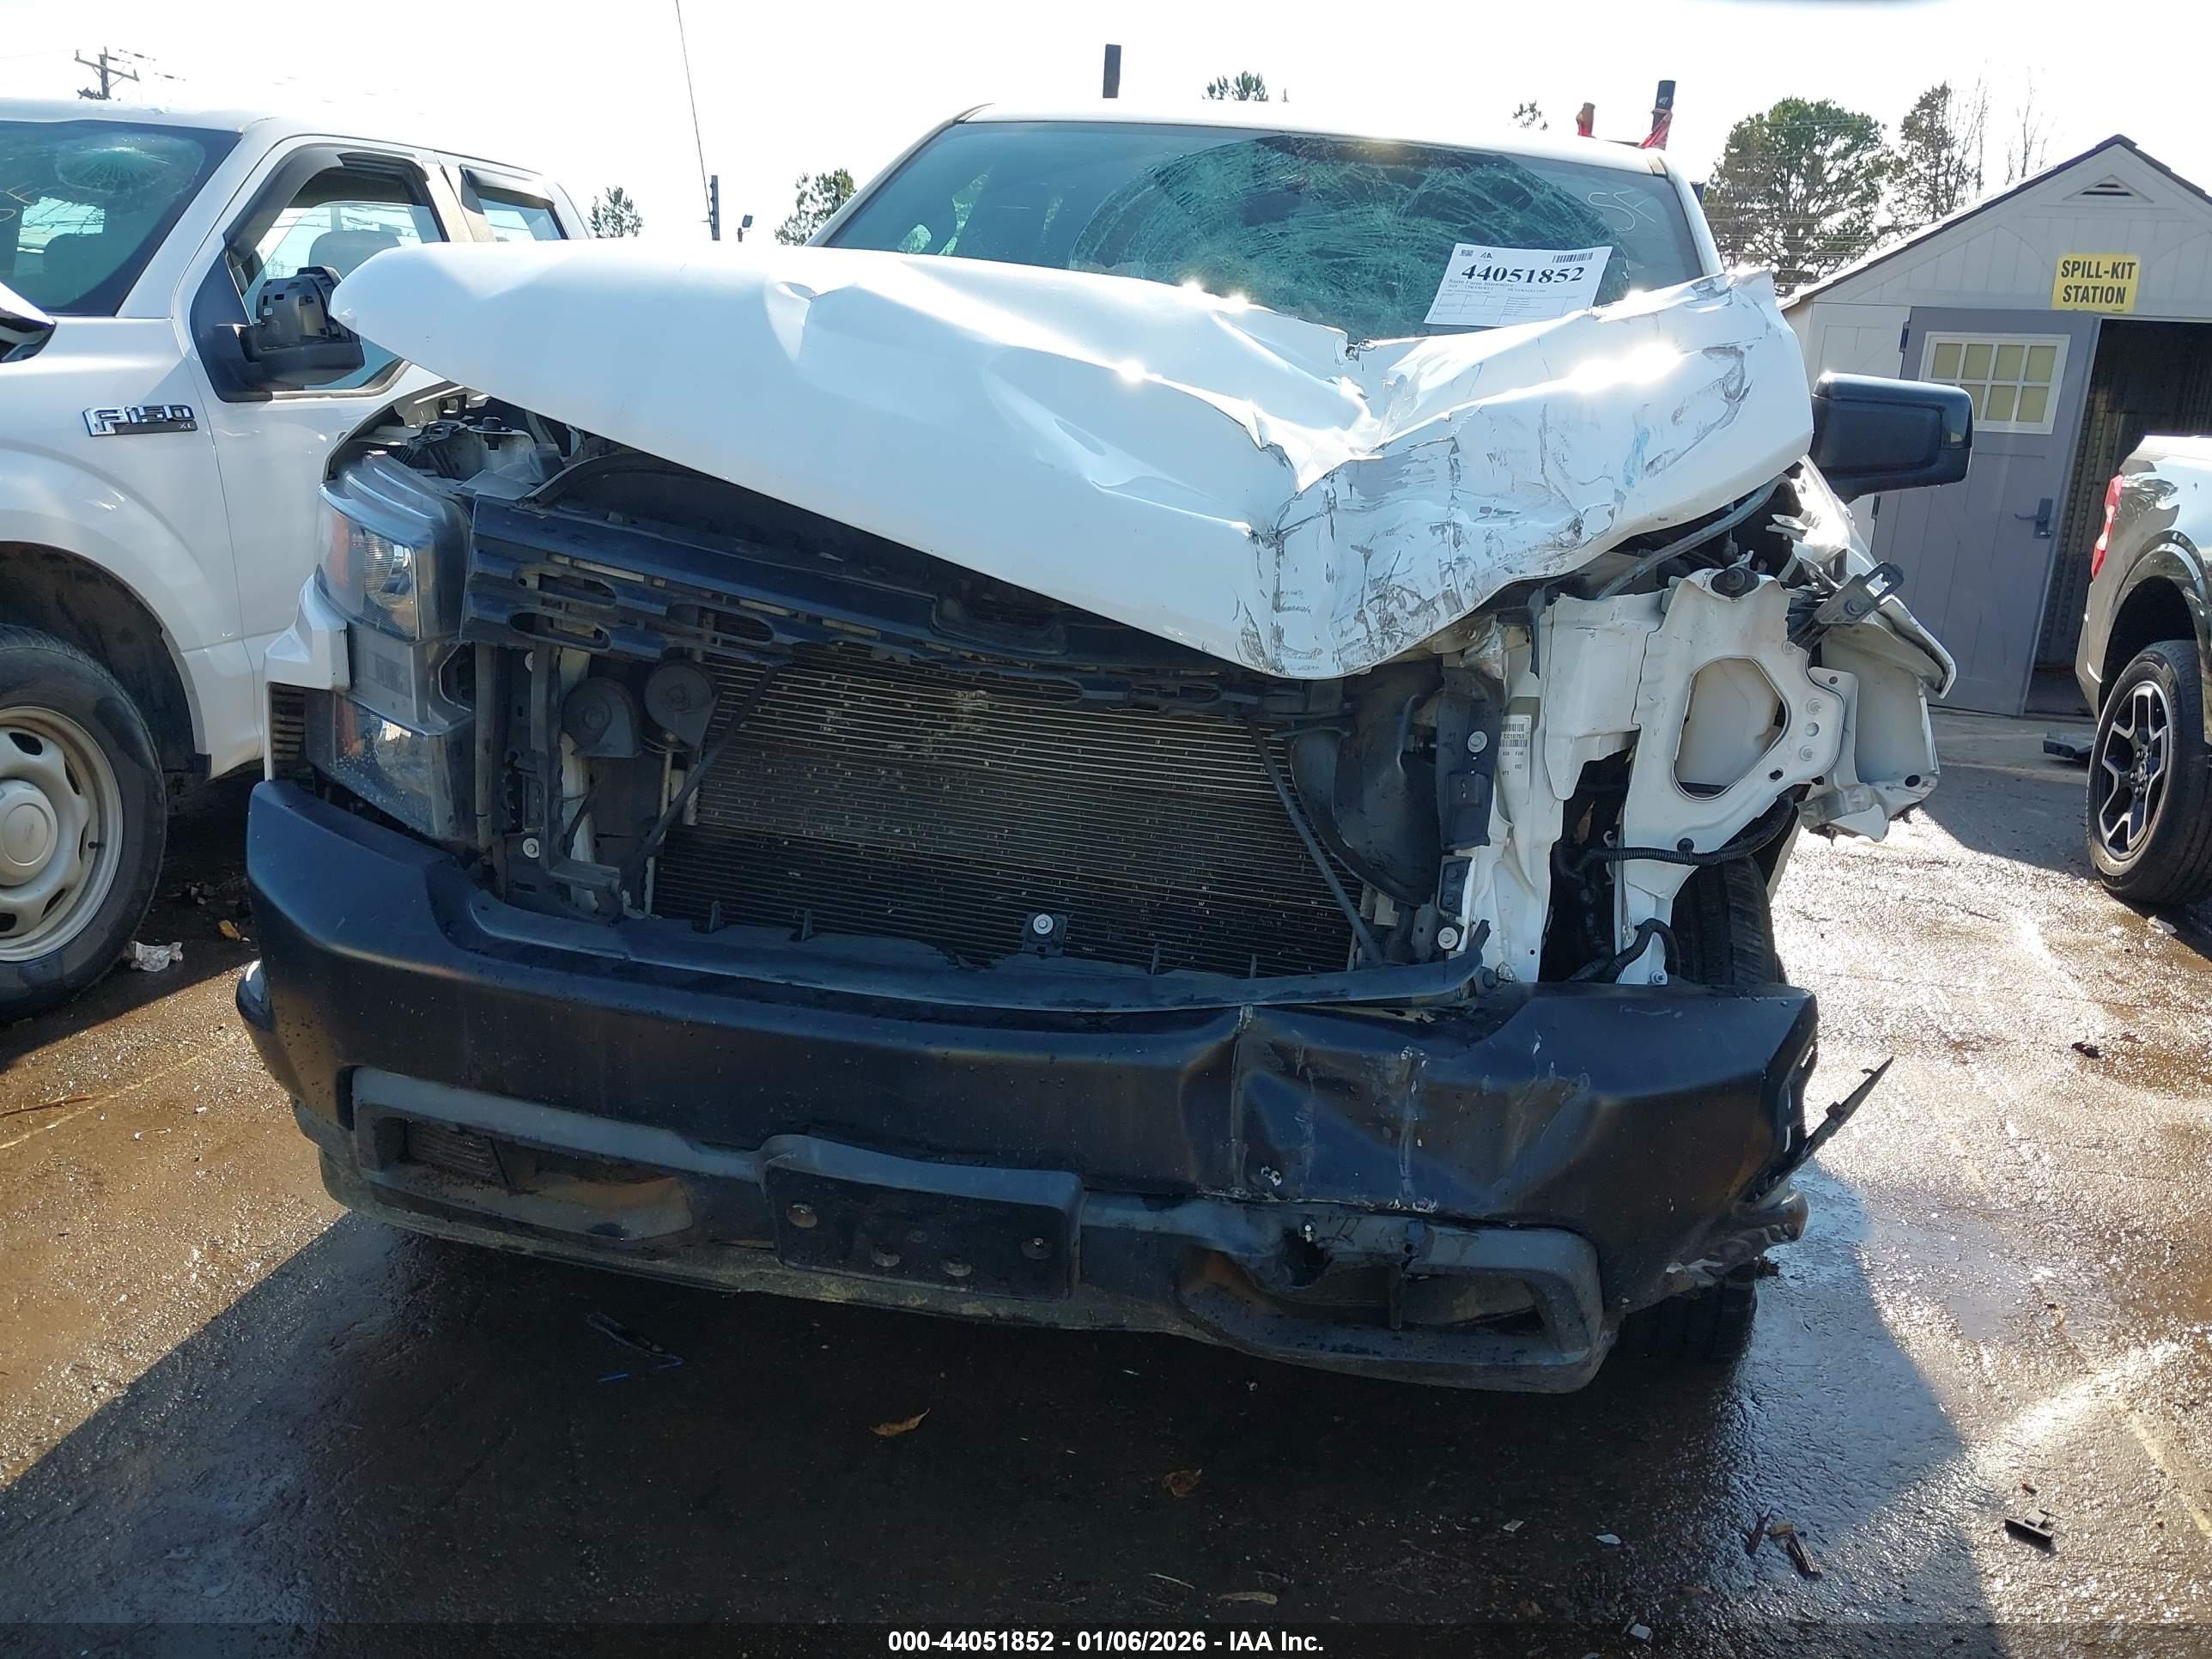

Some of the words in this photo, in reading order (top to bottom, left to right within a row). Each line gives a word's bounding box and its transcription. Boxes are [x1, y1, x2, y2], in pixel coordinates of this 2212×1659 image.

[1461, 264, 1586, 284] 44051852
[2061, 259, 2136, 280] SPILL-KIT
[2063, 284, 2127, 305] STATION
